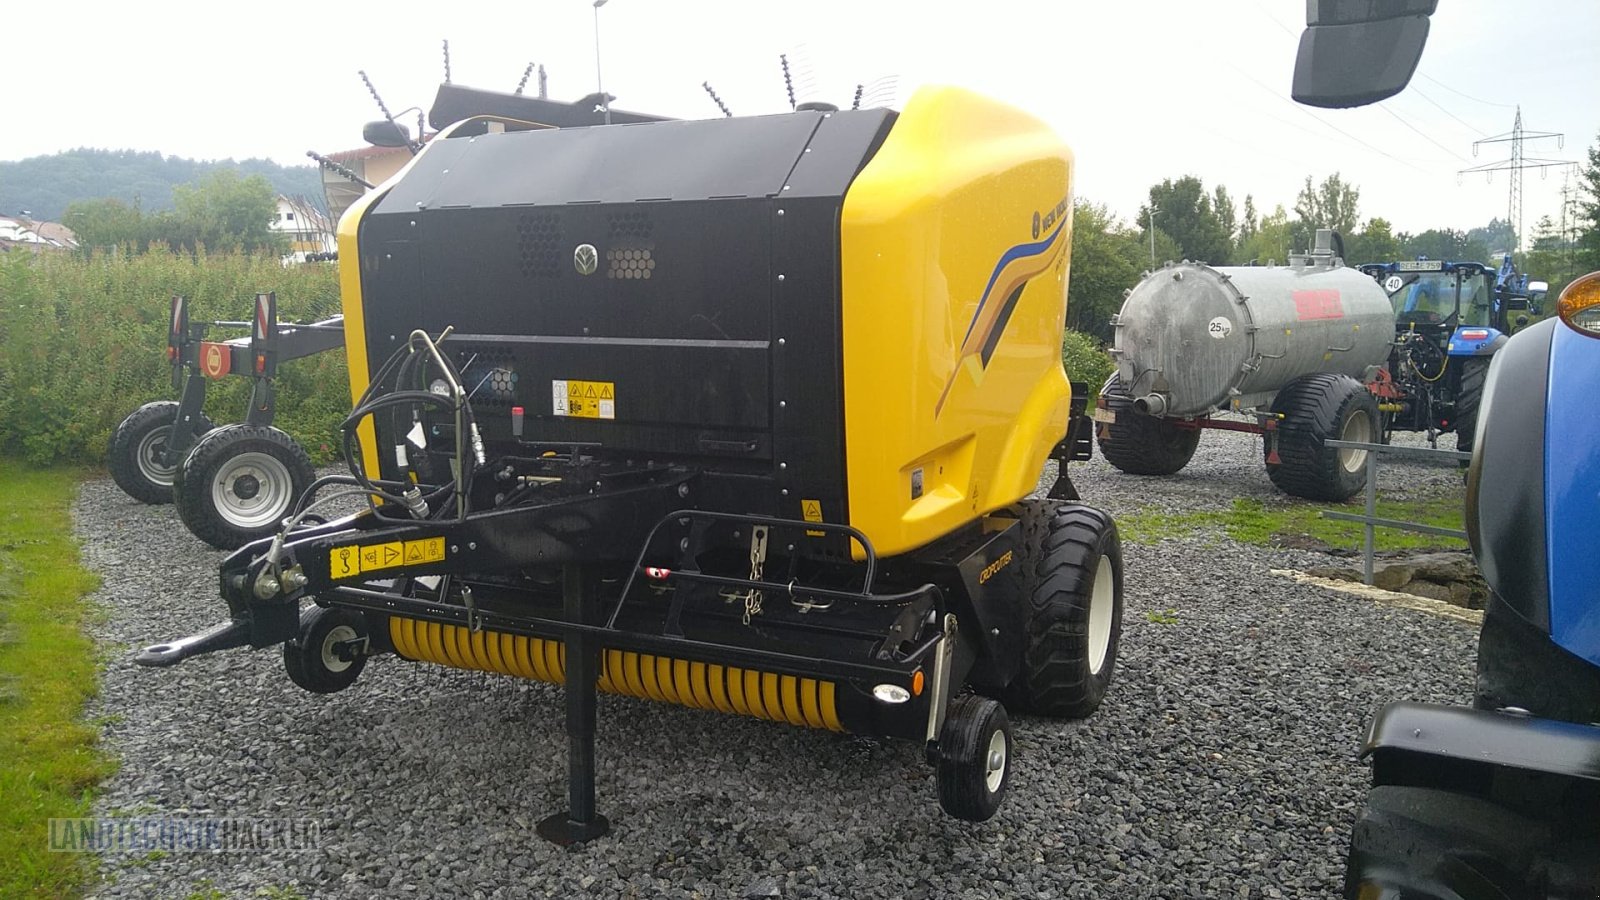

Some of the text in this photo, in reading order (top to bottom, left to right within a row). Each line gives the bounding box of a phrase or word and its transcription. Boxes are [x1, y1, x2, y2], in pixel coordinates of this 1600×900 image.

[1042, 207, 1056, 233] NEW
[1388, 278, 1400, 289] 40
[1210, 322, 1222, 332] 25
[979, 550, 1012, 584] CROPCUTTER
